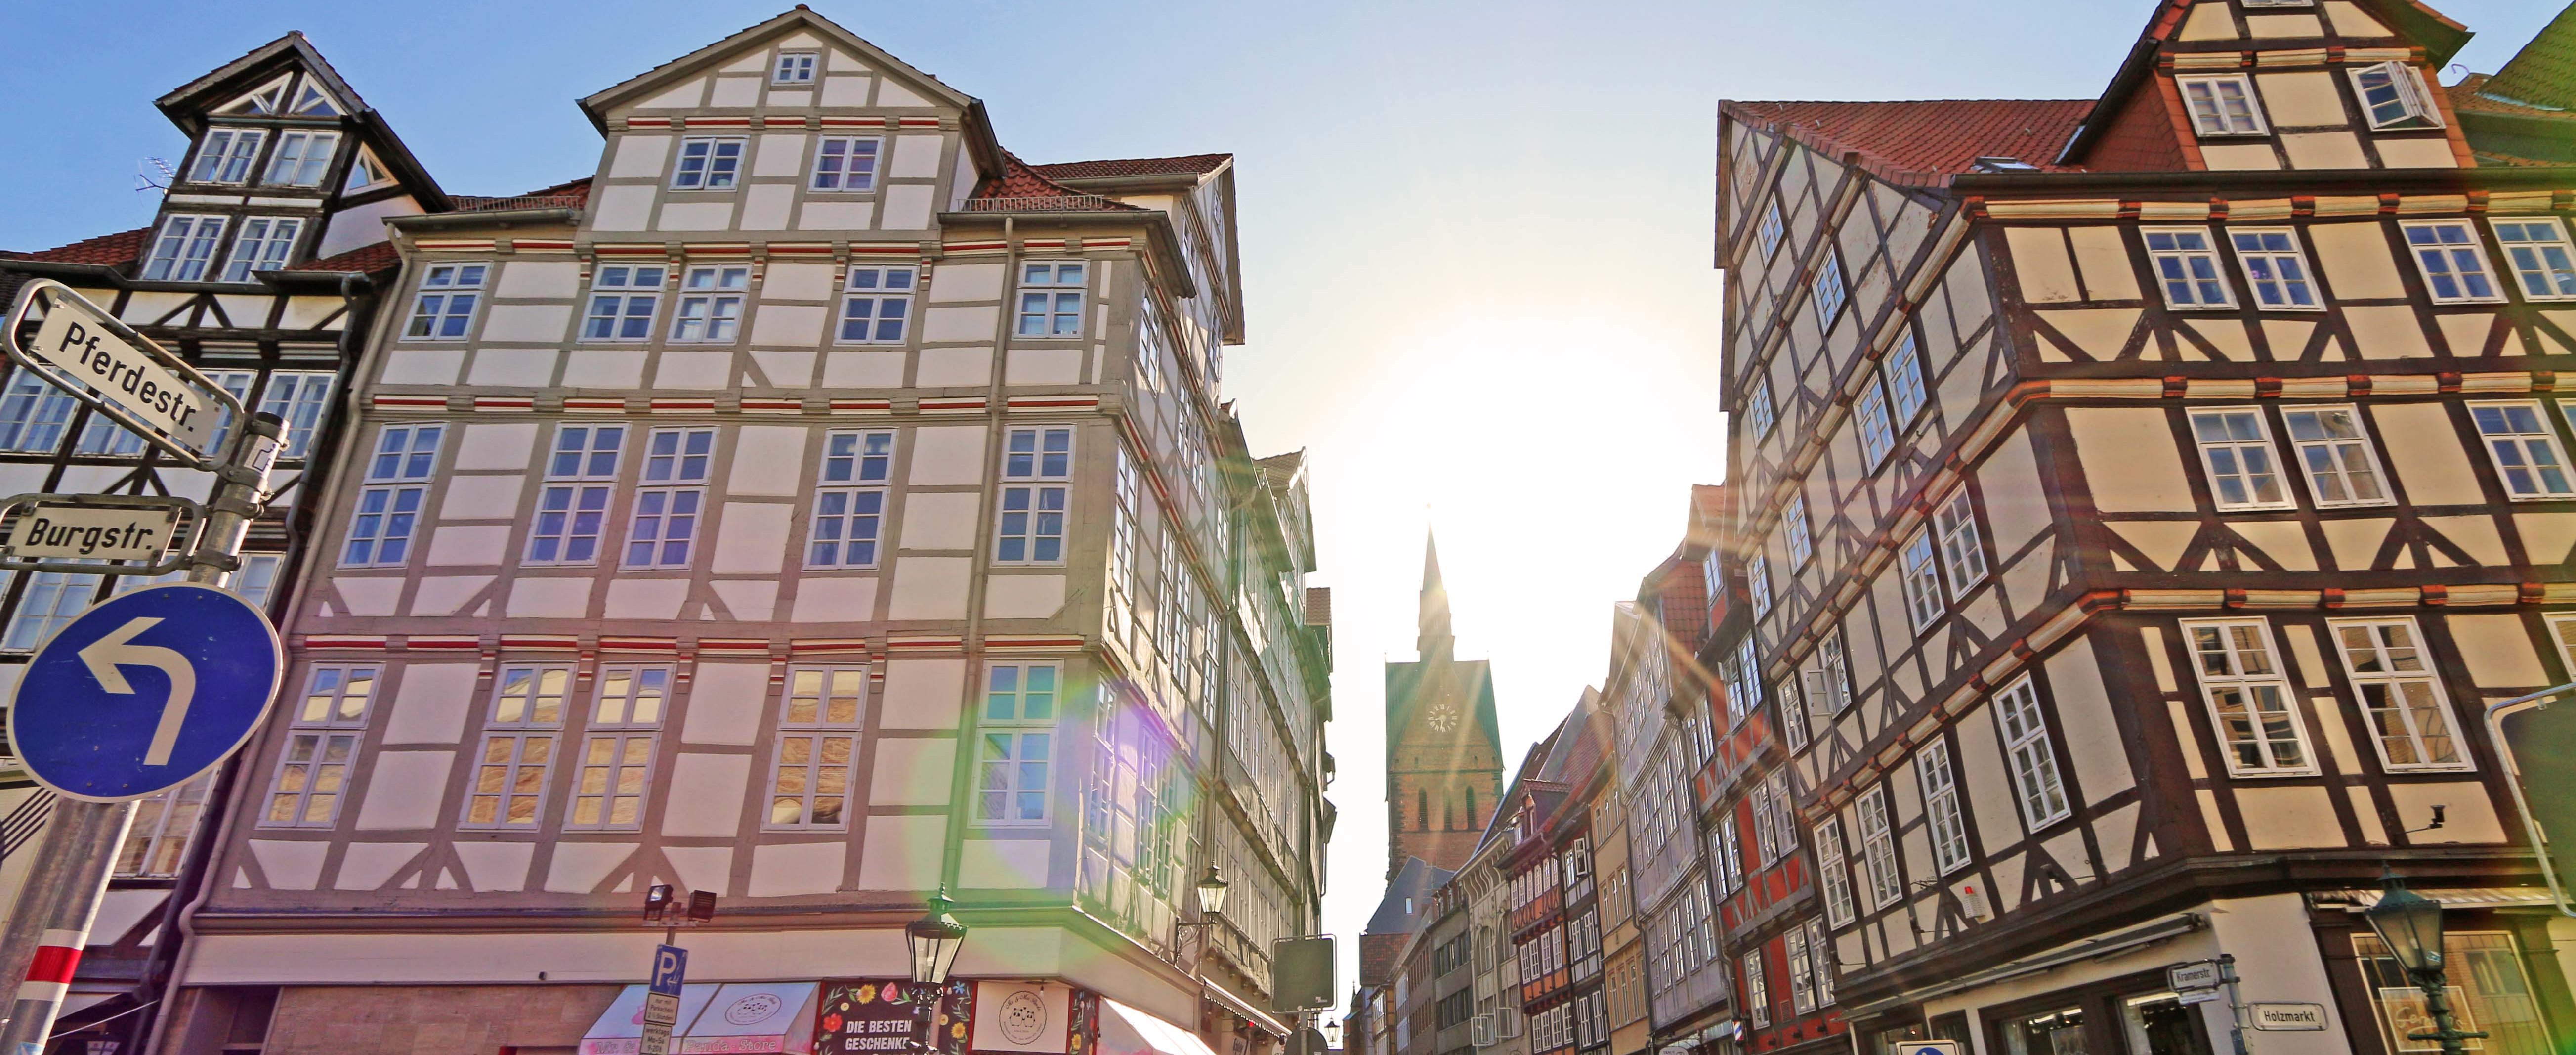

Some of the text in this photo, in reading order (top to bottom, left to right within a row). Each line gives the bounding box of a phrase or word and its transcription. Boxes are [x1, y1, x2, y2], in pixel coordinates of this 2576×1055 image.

[59, 321, 196, 432] Pferdestr.
[25, 518, 153, 554] Burgstr.
[656, 951, 676, 986] P
[846, 1020, 912, 1033] DIE BESTEN
[2264, 1011, 2315, 1023] Holzmarkt
[685, 1039, 729, 1052] Panda
[739, 1039, 776, 1051] Store
